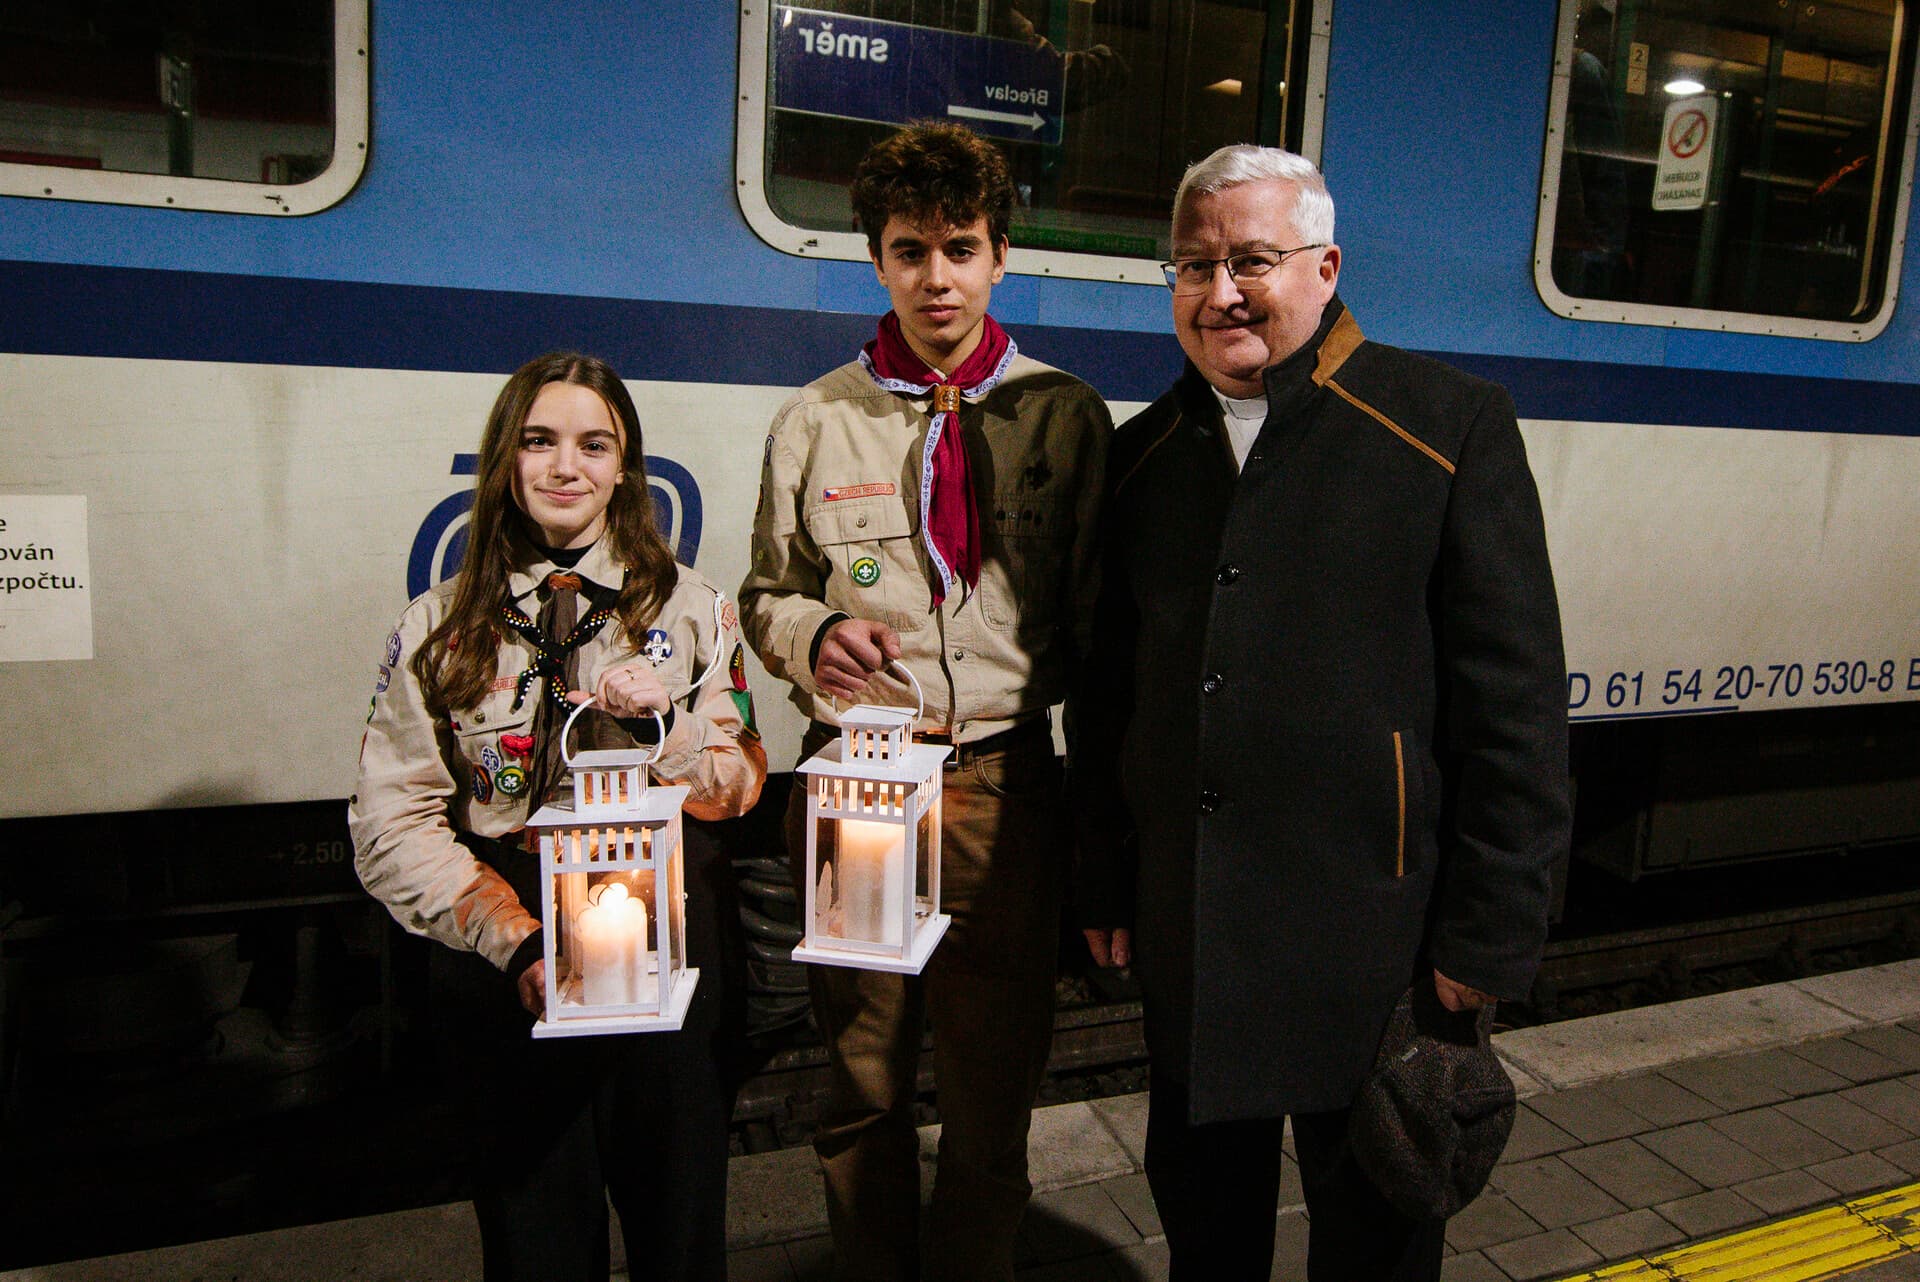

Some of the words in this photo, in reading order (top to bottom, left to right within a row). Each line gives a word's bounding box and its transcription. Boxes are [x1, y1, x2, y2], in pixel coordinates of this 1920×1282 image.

[1606, 671, 1644, 708] 61
[1661, 668, 1703, 705] 54
[1713, 663, 1804, 701] 20-70
[1812, 659, 1896, 696] 530-8
